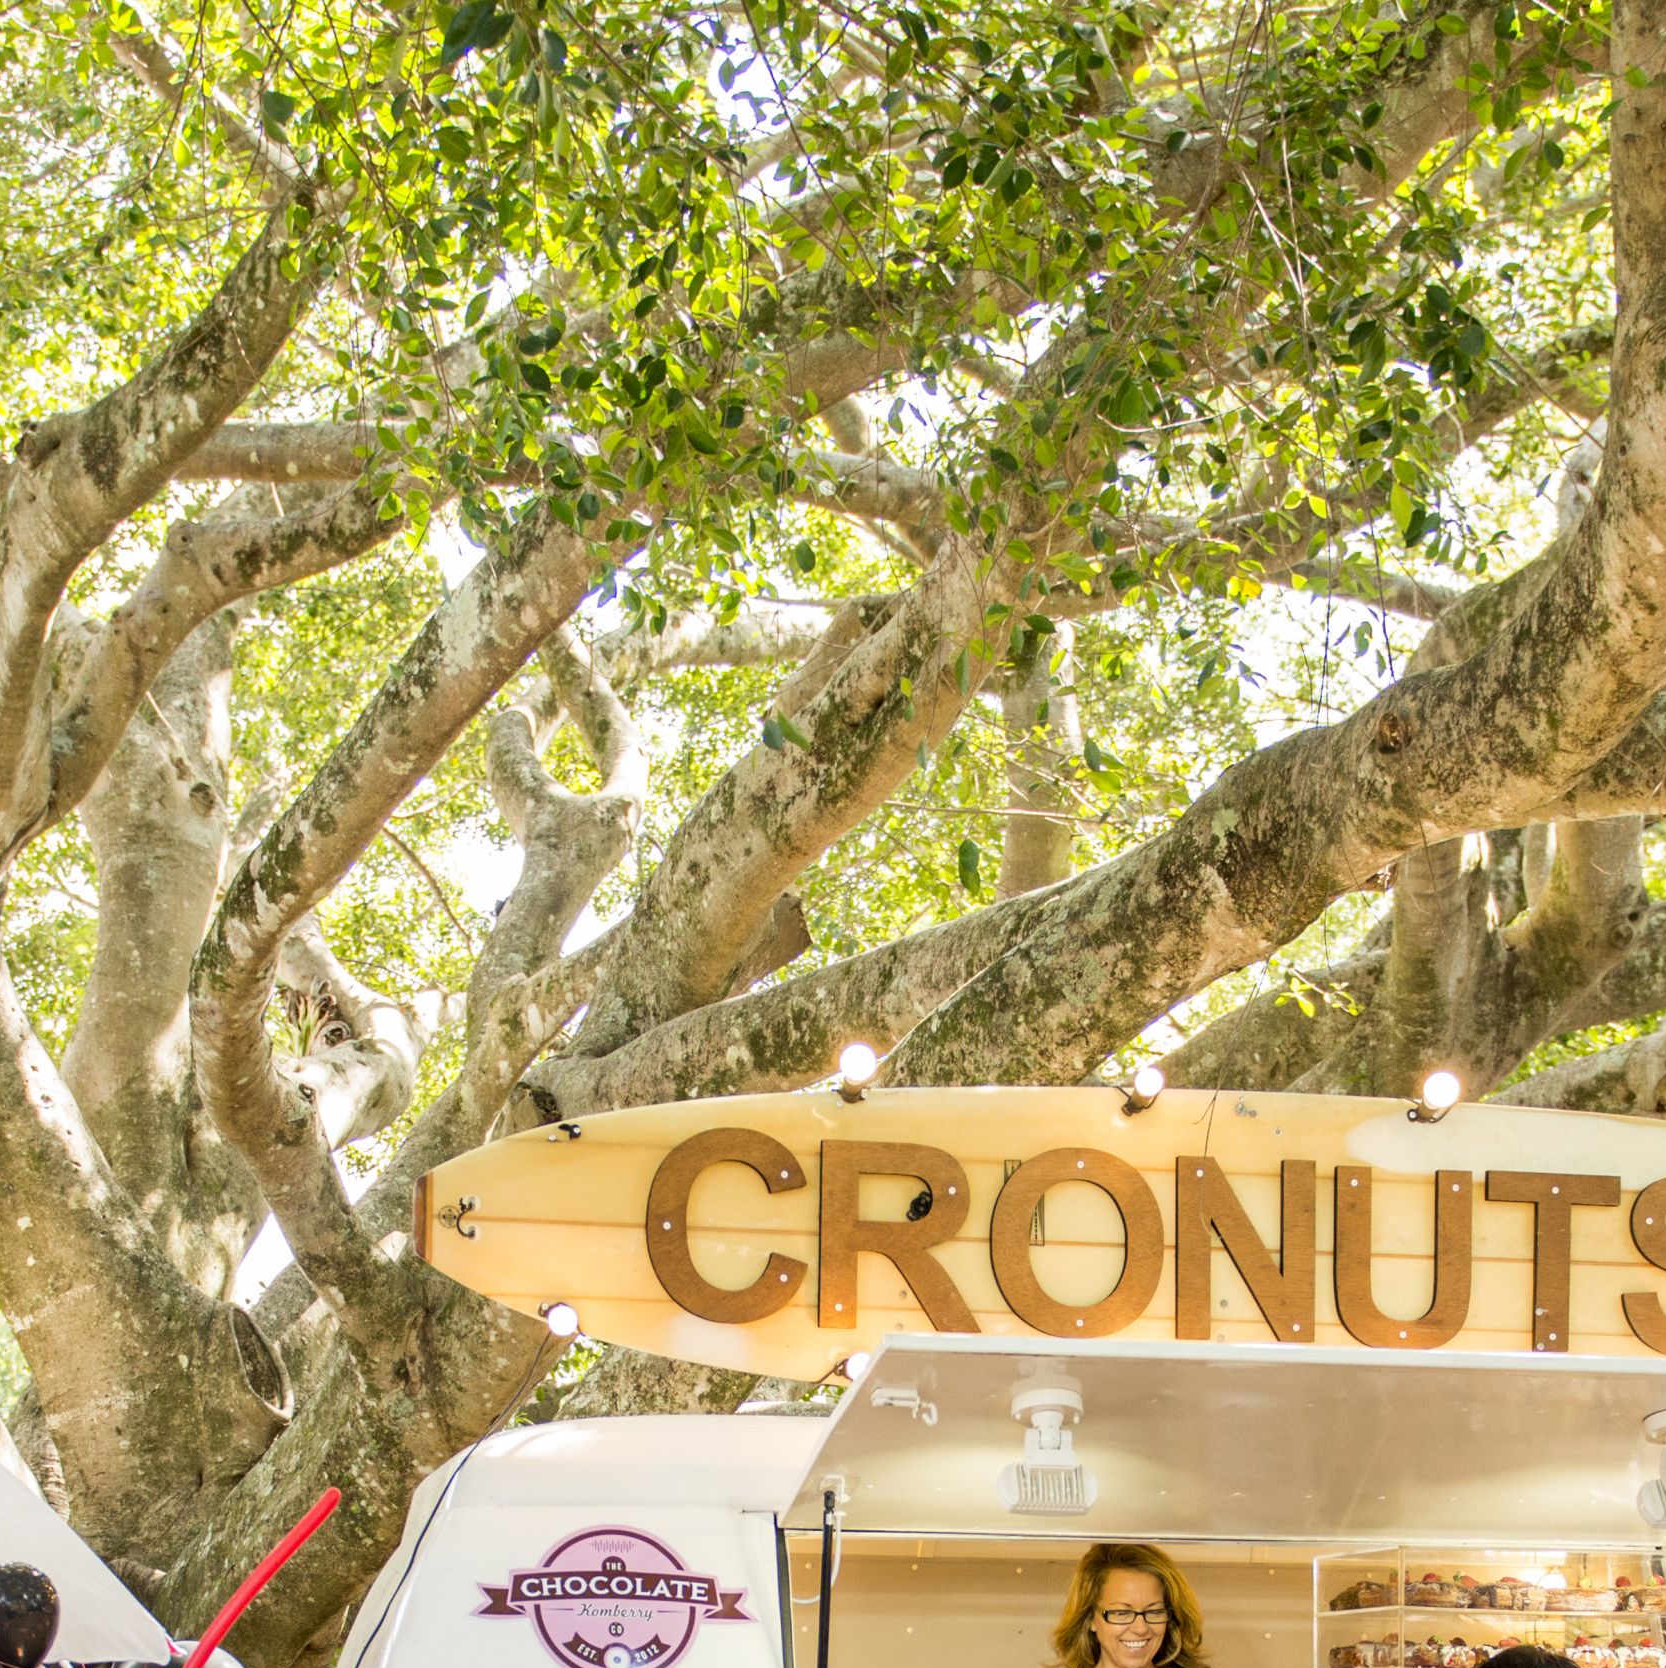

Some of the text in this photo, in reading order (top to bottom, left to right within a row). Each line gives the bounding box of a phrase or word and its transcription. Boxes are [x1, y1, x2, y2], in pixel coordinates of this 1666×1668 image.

[605, 1561, 622, 1571] THE
[519, 1575, 709, 1602] CHOCOLATE
[610, 1624, 623, 1634] CO
[576, 1643, 660, 1663] EST. 2012
